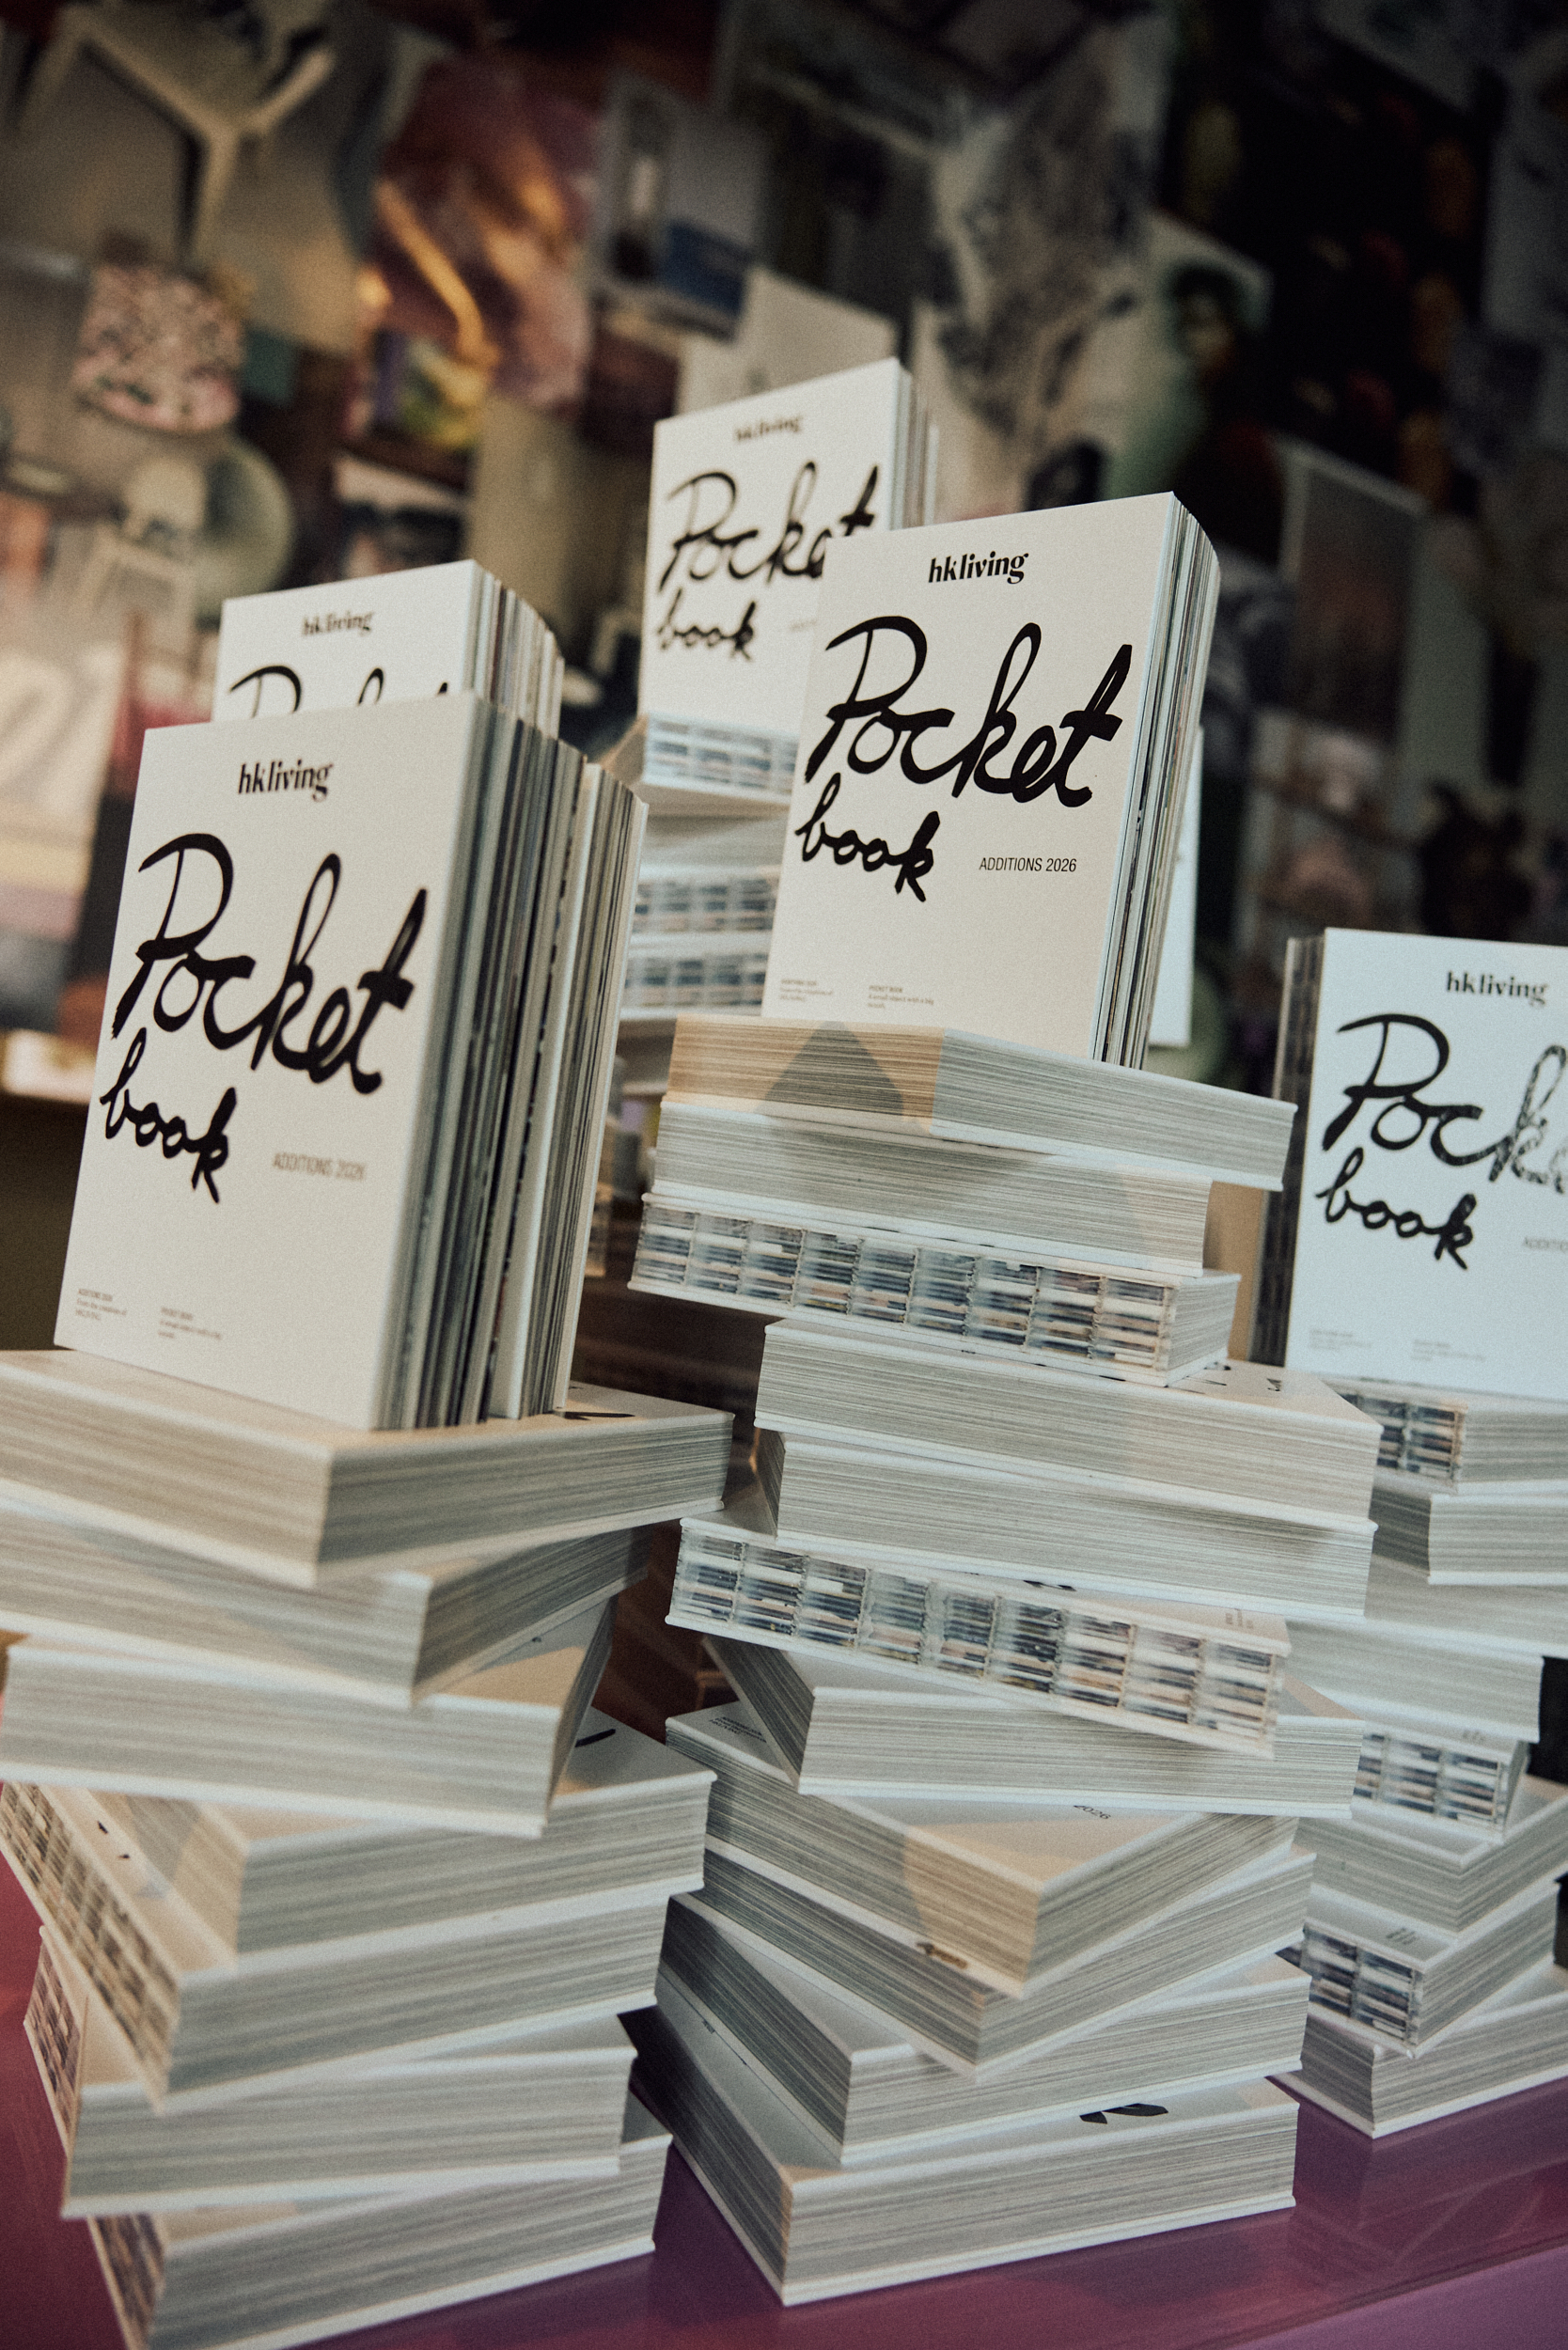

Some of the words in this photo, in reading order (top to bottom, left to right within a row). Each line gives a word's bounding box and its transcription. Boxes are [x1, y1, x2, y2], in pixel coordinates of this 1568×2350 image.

[928, 549, 1031, 585] hkliving
[658, 587, 757, 661] book
[805, 616, 1133, 807] Pocket
[237, 758, 334, 802] hkliving
[794, 773, 941, 902] book
[979, 856, 1043, 872] ADDITIONS
[1045, 857, 1077, 872] 2026
[112, 833, 429, 1095] Pocket
[1446, 970, 1549, 1006] hkliving
[100, 1027, 237, 1204] book
[1315, 1146, 1478, 1271] book
